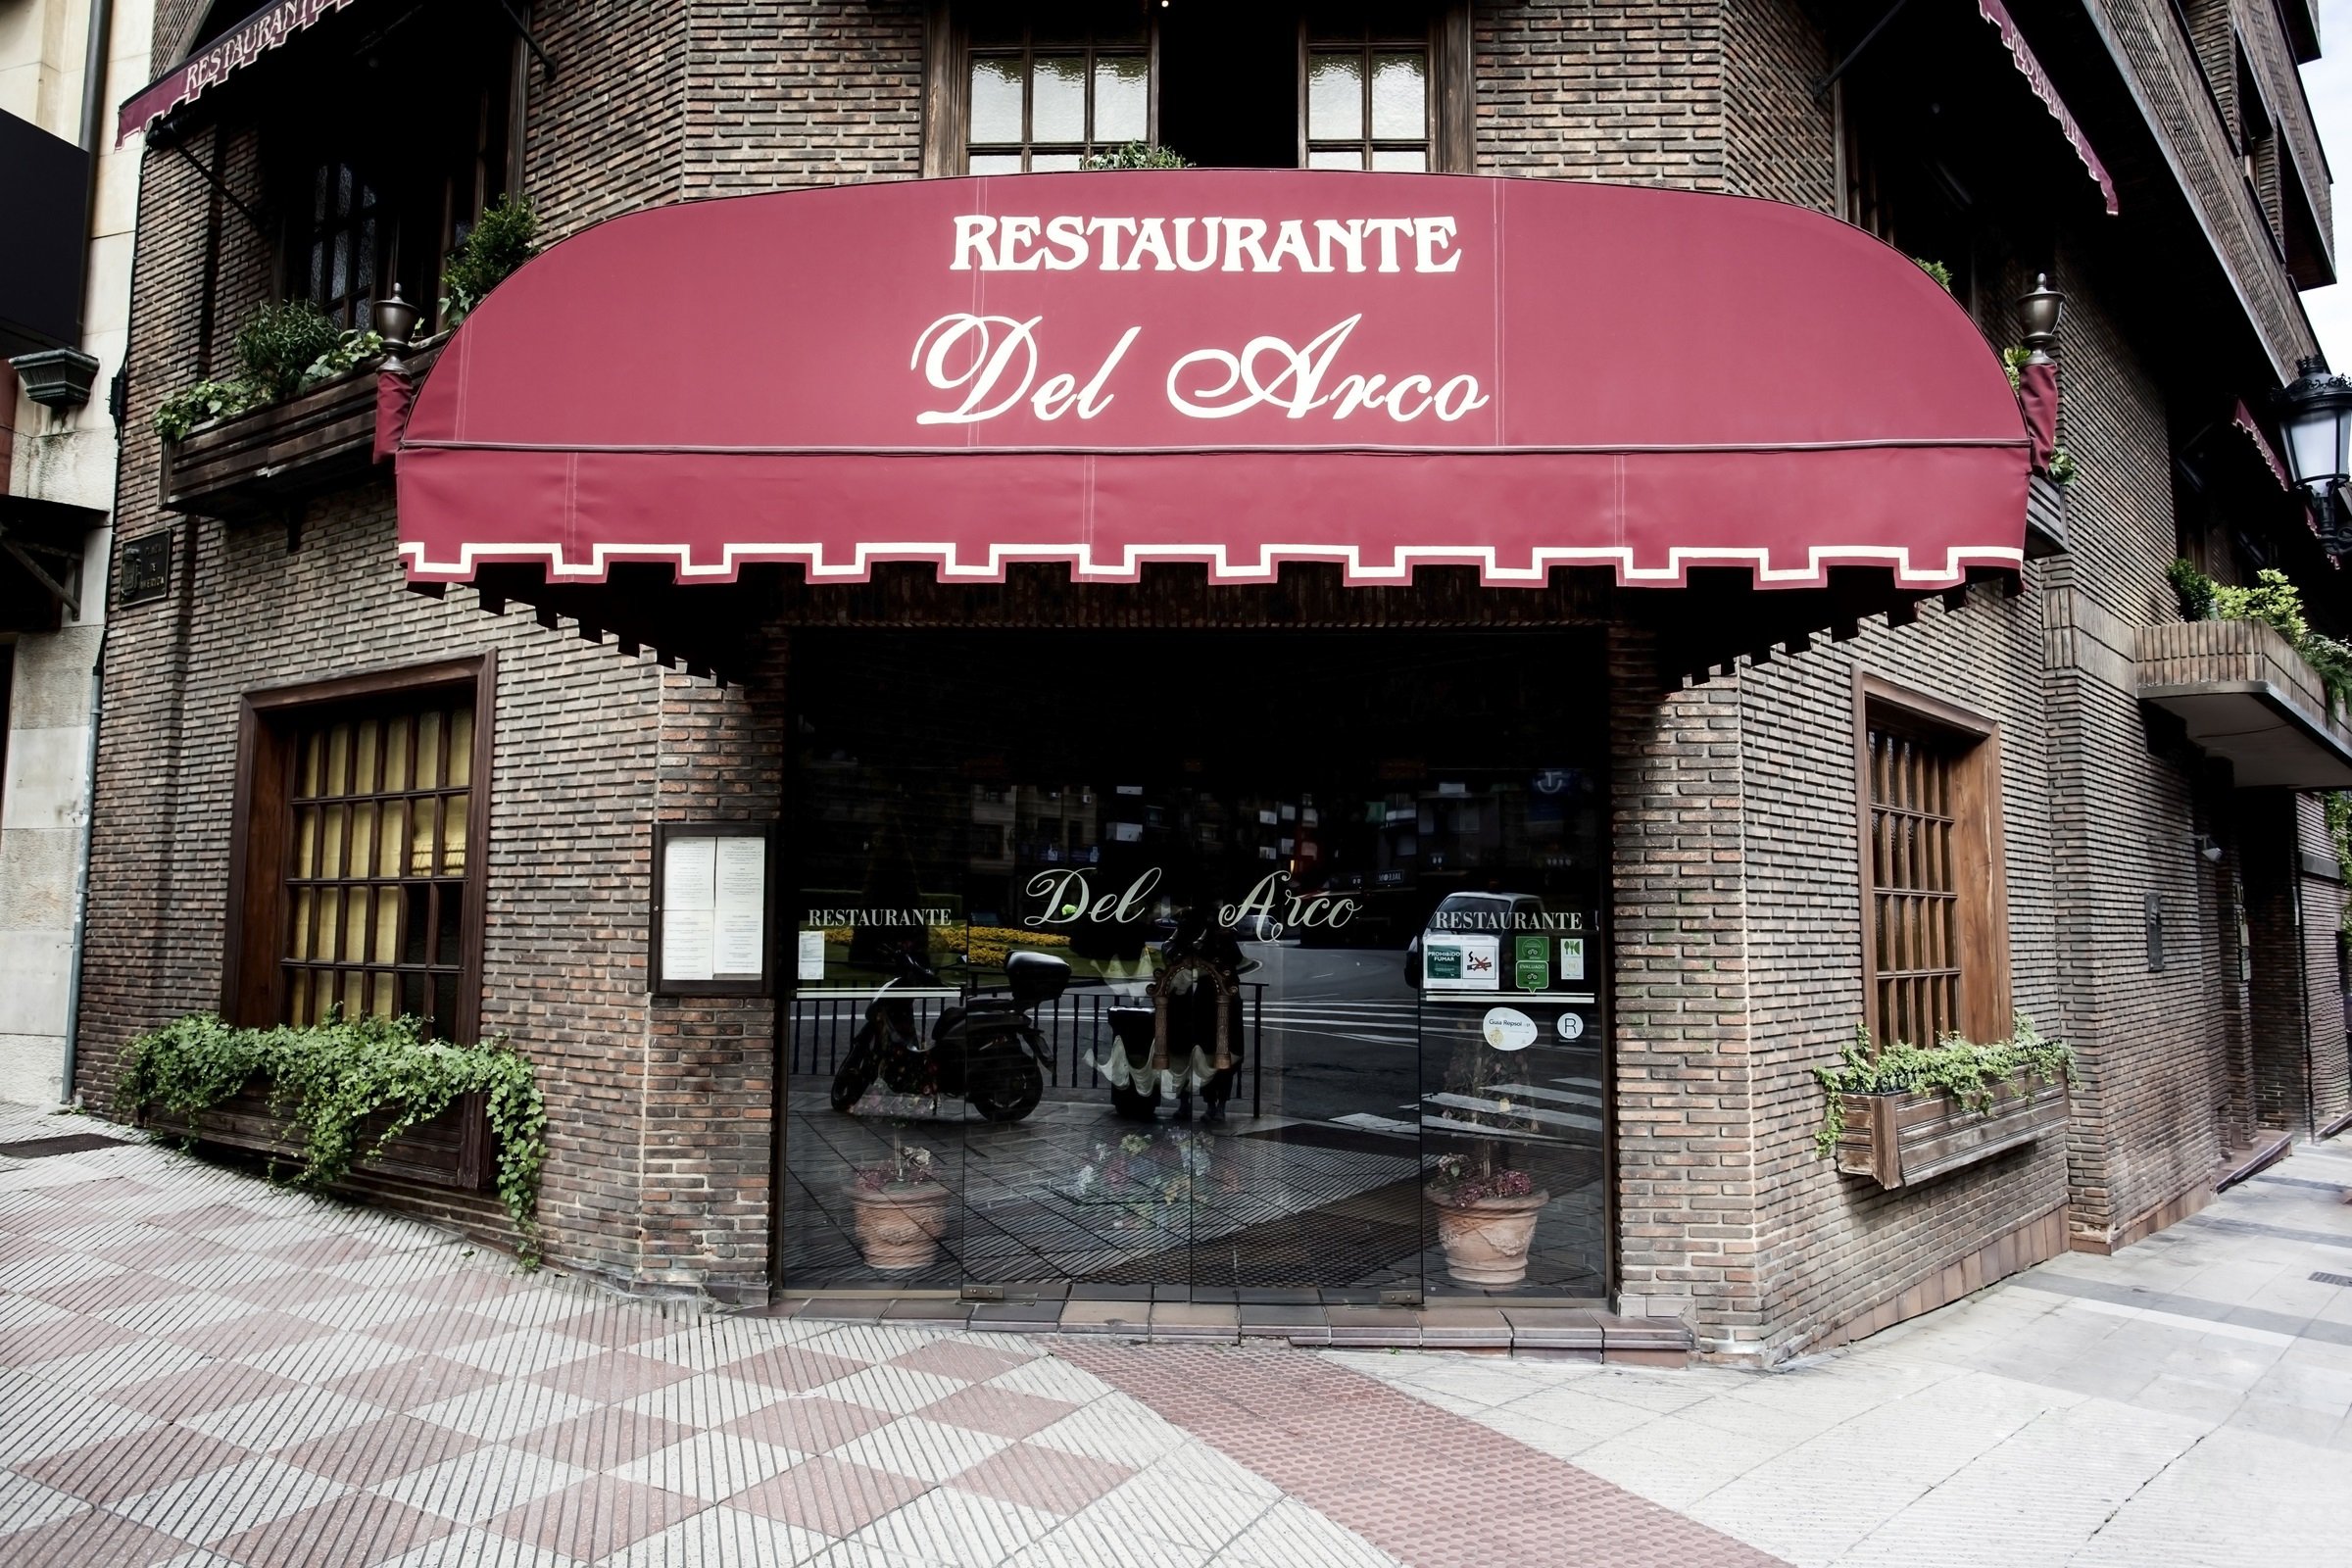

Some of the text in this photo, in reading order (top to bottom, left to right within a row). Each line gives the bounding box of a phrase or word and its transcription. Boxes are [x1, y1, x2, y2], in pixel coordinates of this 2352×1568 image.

[950, 215, 1462, 273] RESTAURANTE
[910, 313, 1490, 424] Del Arco
[808, 908, 952, 926] RESTAURANTE
[1024, 866, 1363, 943] Del Arco
[1435, 910, 1583, 930] RESTAURANTE
[1564, 1017, 1577, 1034] R
